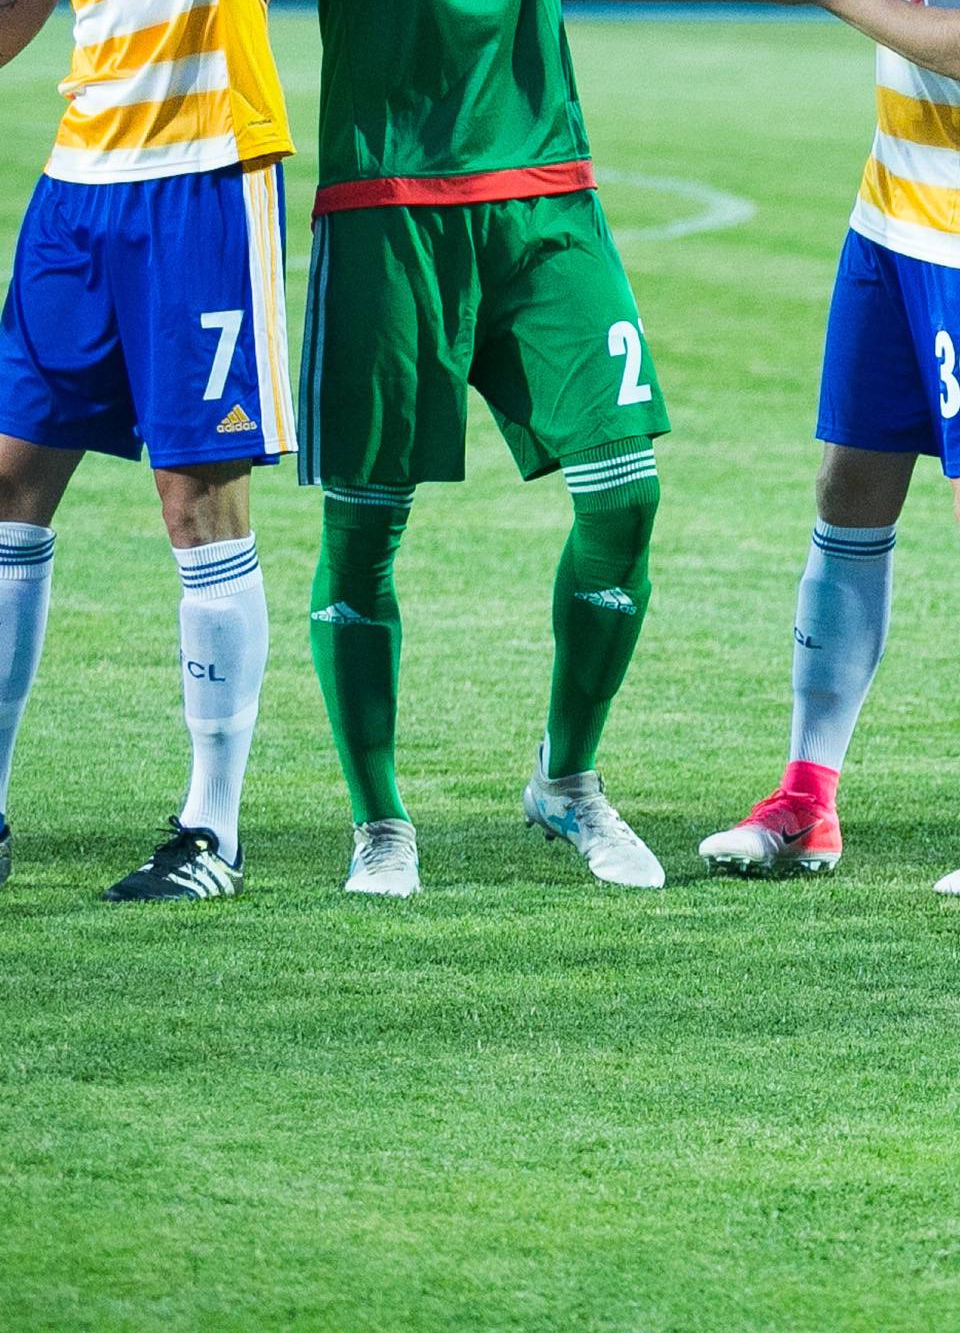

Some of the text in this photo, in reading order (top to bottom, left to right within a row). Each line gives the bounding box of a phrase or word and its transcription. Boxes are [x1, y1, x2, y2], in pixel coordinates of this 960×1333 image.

[200, 310, 243, 401] 7
[606, 319, 652, 407] 2
[216, 420, 258, 434] adidas
[793, 626, 824, 651] CL
[180, 648, 226, 683] CL
